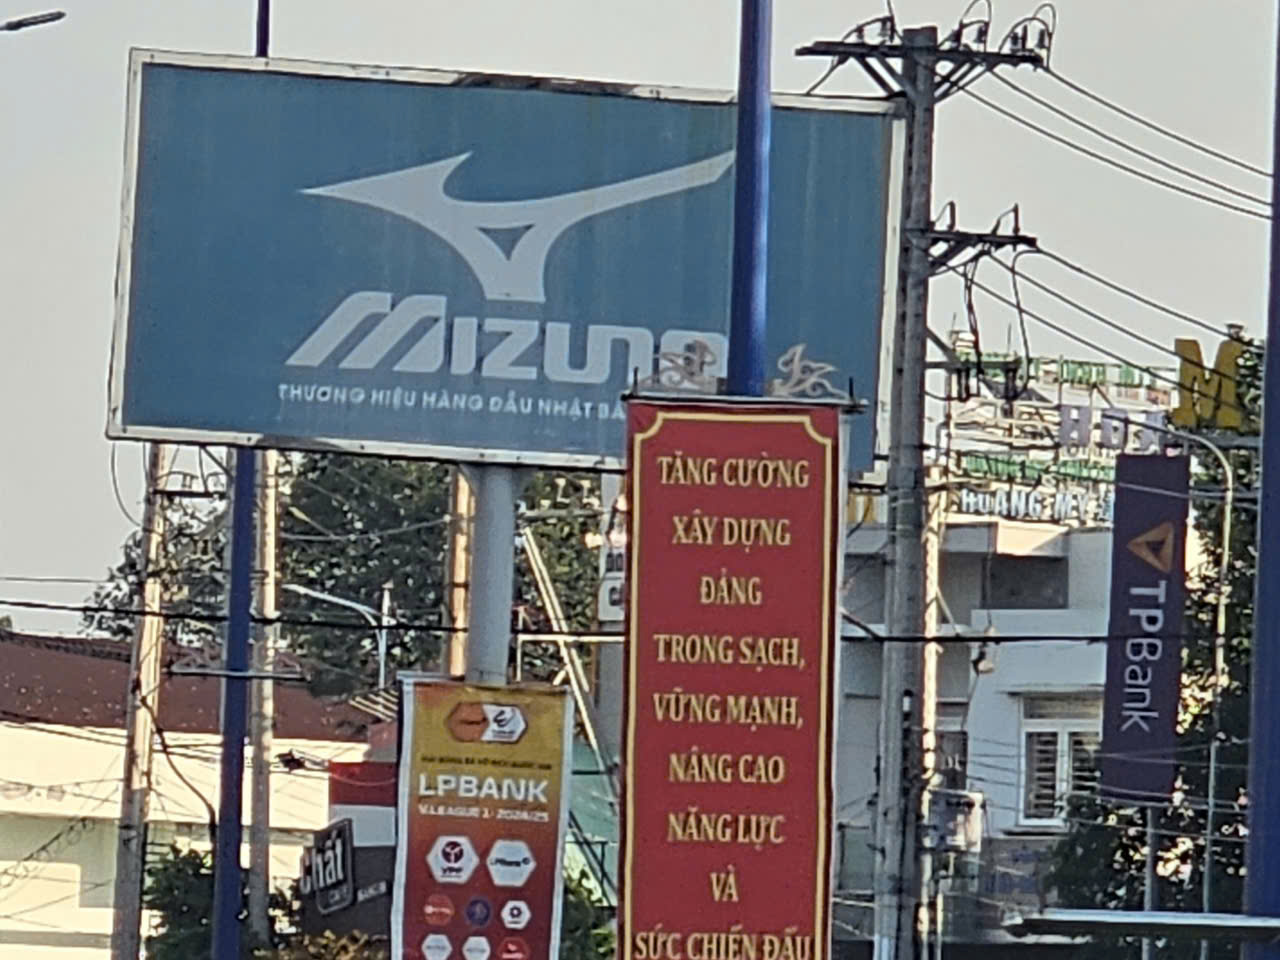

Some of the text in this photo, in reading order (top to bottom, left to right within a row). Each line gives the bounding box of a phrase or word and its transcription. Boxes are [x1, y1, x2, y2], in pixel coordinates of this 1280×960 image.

[277, 383, 366, 404] THƯƠNG
[657, 450, 810, 488] TĂNG CƯỜNG
[671, 508, 791, 553] XÂY DỰNG
[699, 567, 762, 605] ĐẢNG
[653, 633, 805, 672] TRONG SẠCH,
[1120, 579, 1168, 733] TPBank
[653, 687, 804, 732] VỮNG MẠNH,
[669, 745, 785, 784] NÂNG CAO
[419, 774, 549, 803] LPBANK
[668, 806, 786, 851] NĂNG LỰC
[710, 864, 739, 902] VÀ
[634, 923, 682, 960] SỨC
